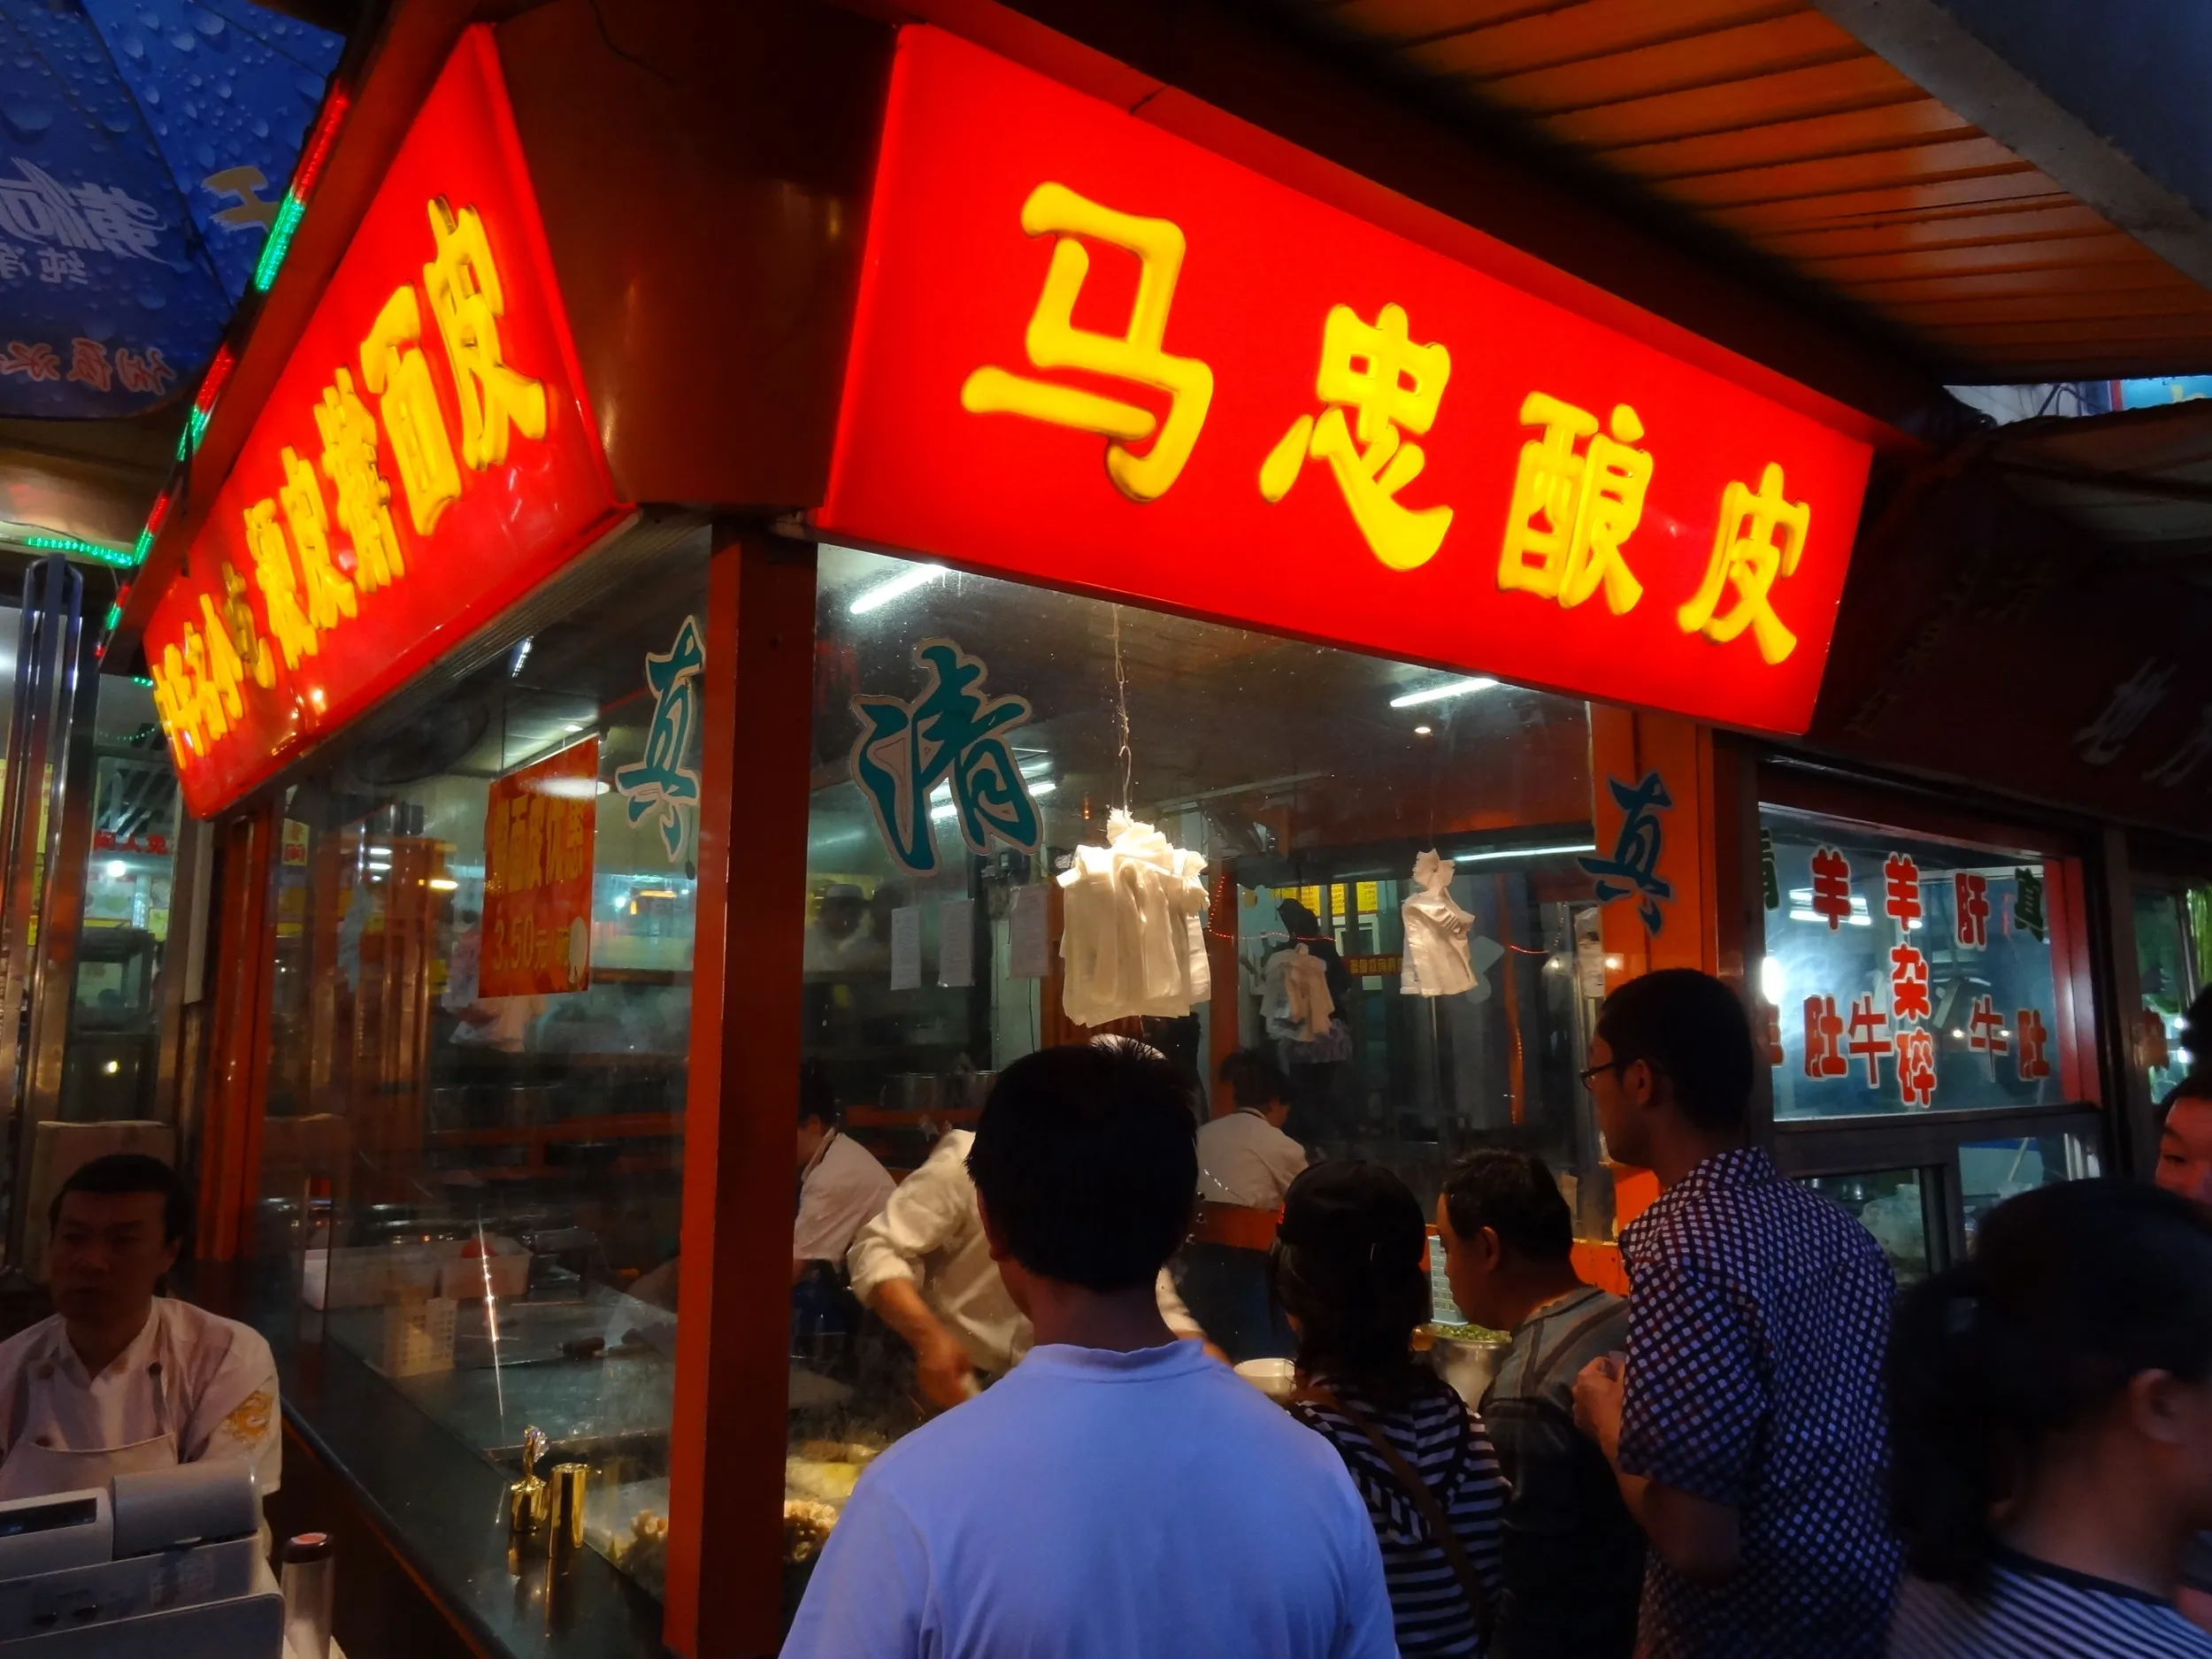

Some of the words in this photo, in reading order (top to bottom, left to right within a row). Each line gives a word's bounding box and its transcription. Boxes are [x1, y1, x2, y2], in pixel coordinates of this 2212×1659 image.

[962, 181, 1810, 664] 马忠酿皮
[852, 638, 1043, 877] 清
[1578, 772, 1675, 935] 真
